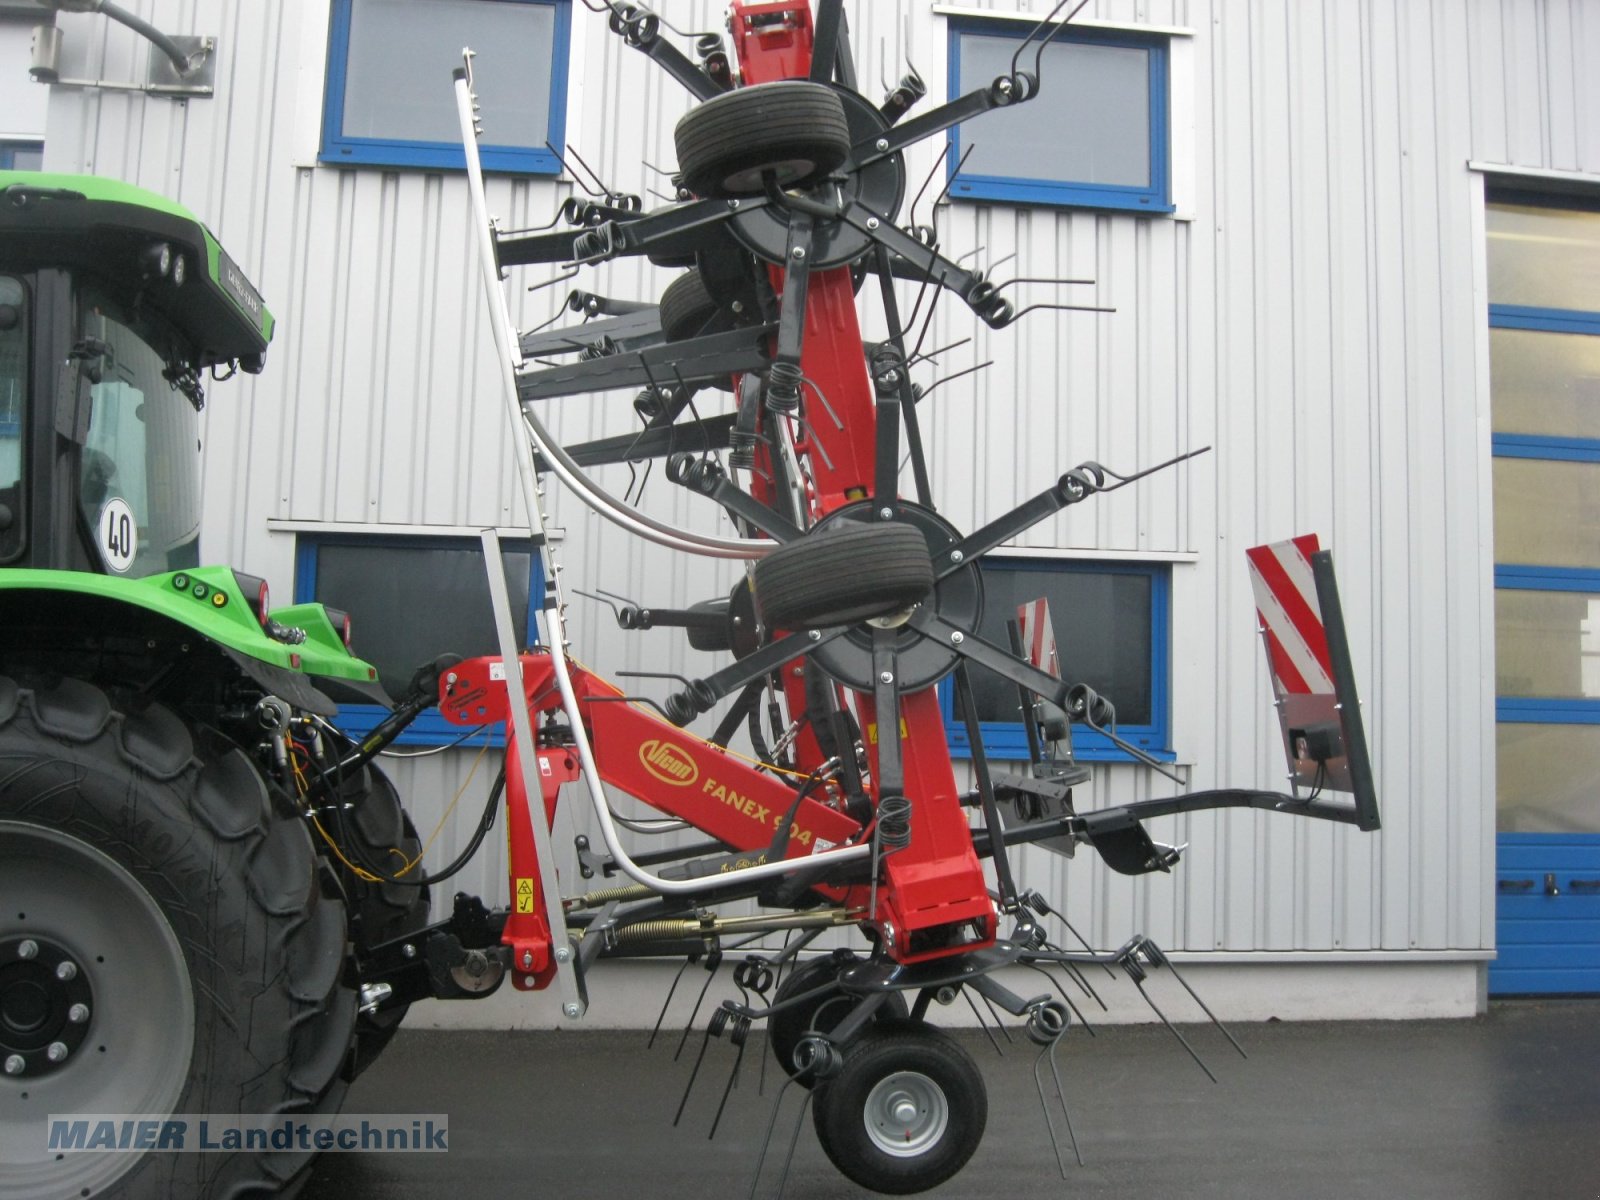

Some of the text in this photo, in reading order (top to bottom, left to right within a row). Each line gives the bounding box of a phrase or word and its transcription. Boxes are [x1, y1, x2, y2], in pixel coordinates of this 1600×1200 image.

[108, 510, 130, 559] 40
[646, 740, 693, 779] Vicon
[702, 778, 770, 824] FANEX
